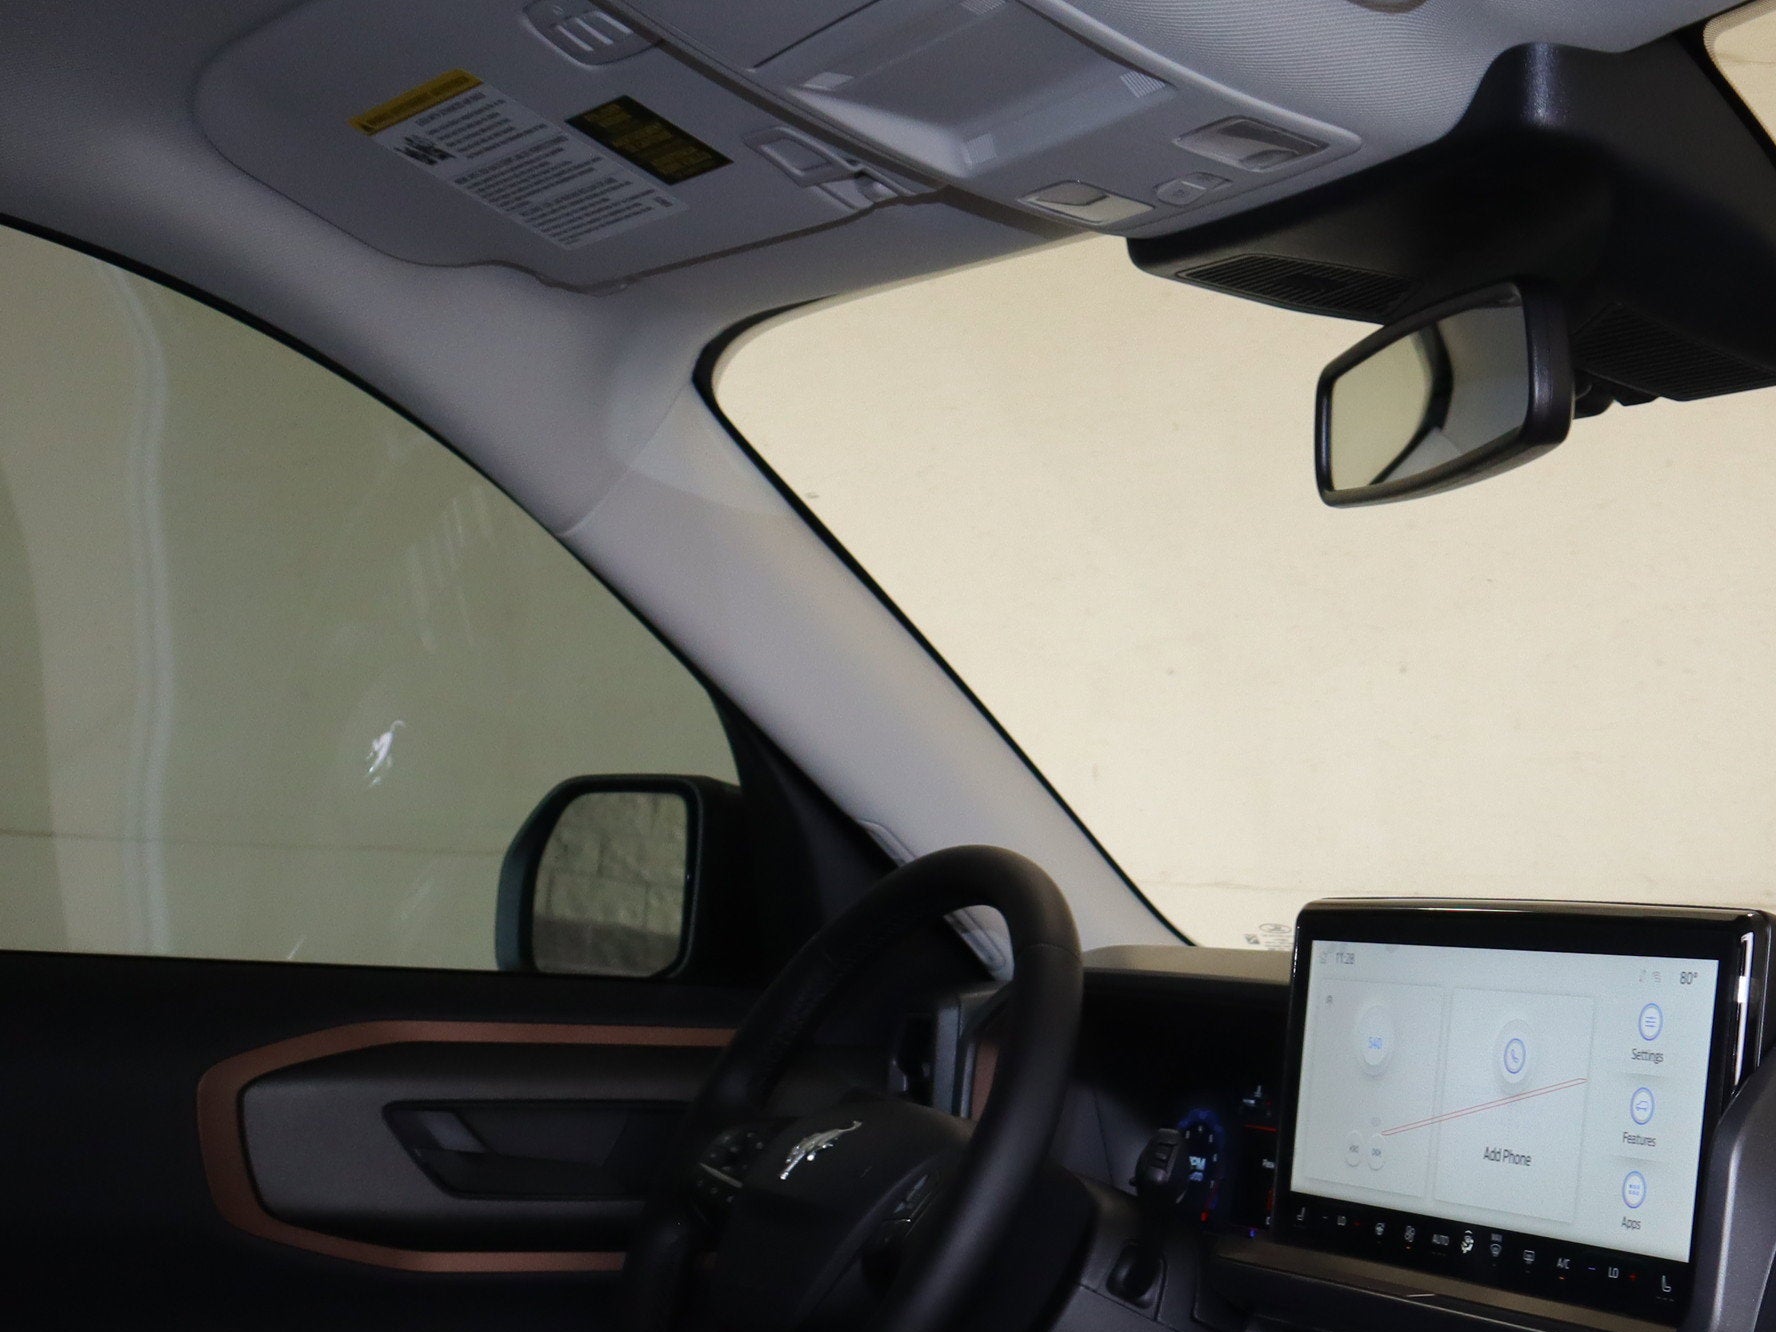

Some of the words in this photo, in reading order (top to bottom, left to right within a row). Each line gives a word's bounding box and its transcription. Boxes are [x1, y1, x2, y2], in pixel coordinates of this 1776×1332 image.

[1631, 1048, 1665, 1064] Settings
[1621, 1131, 1657, 1148] Features
[1483, 1147, 1503, 1162] Add
[1504, 1149, 1532, 1167] Phone
[1620, 1215, 1642, 1231] Apps
